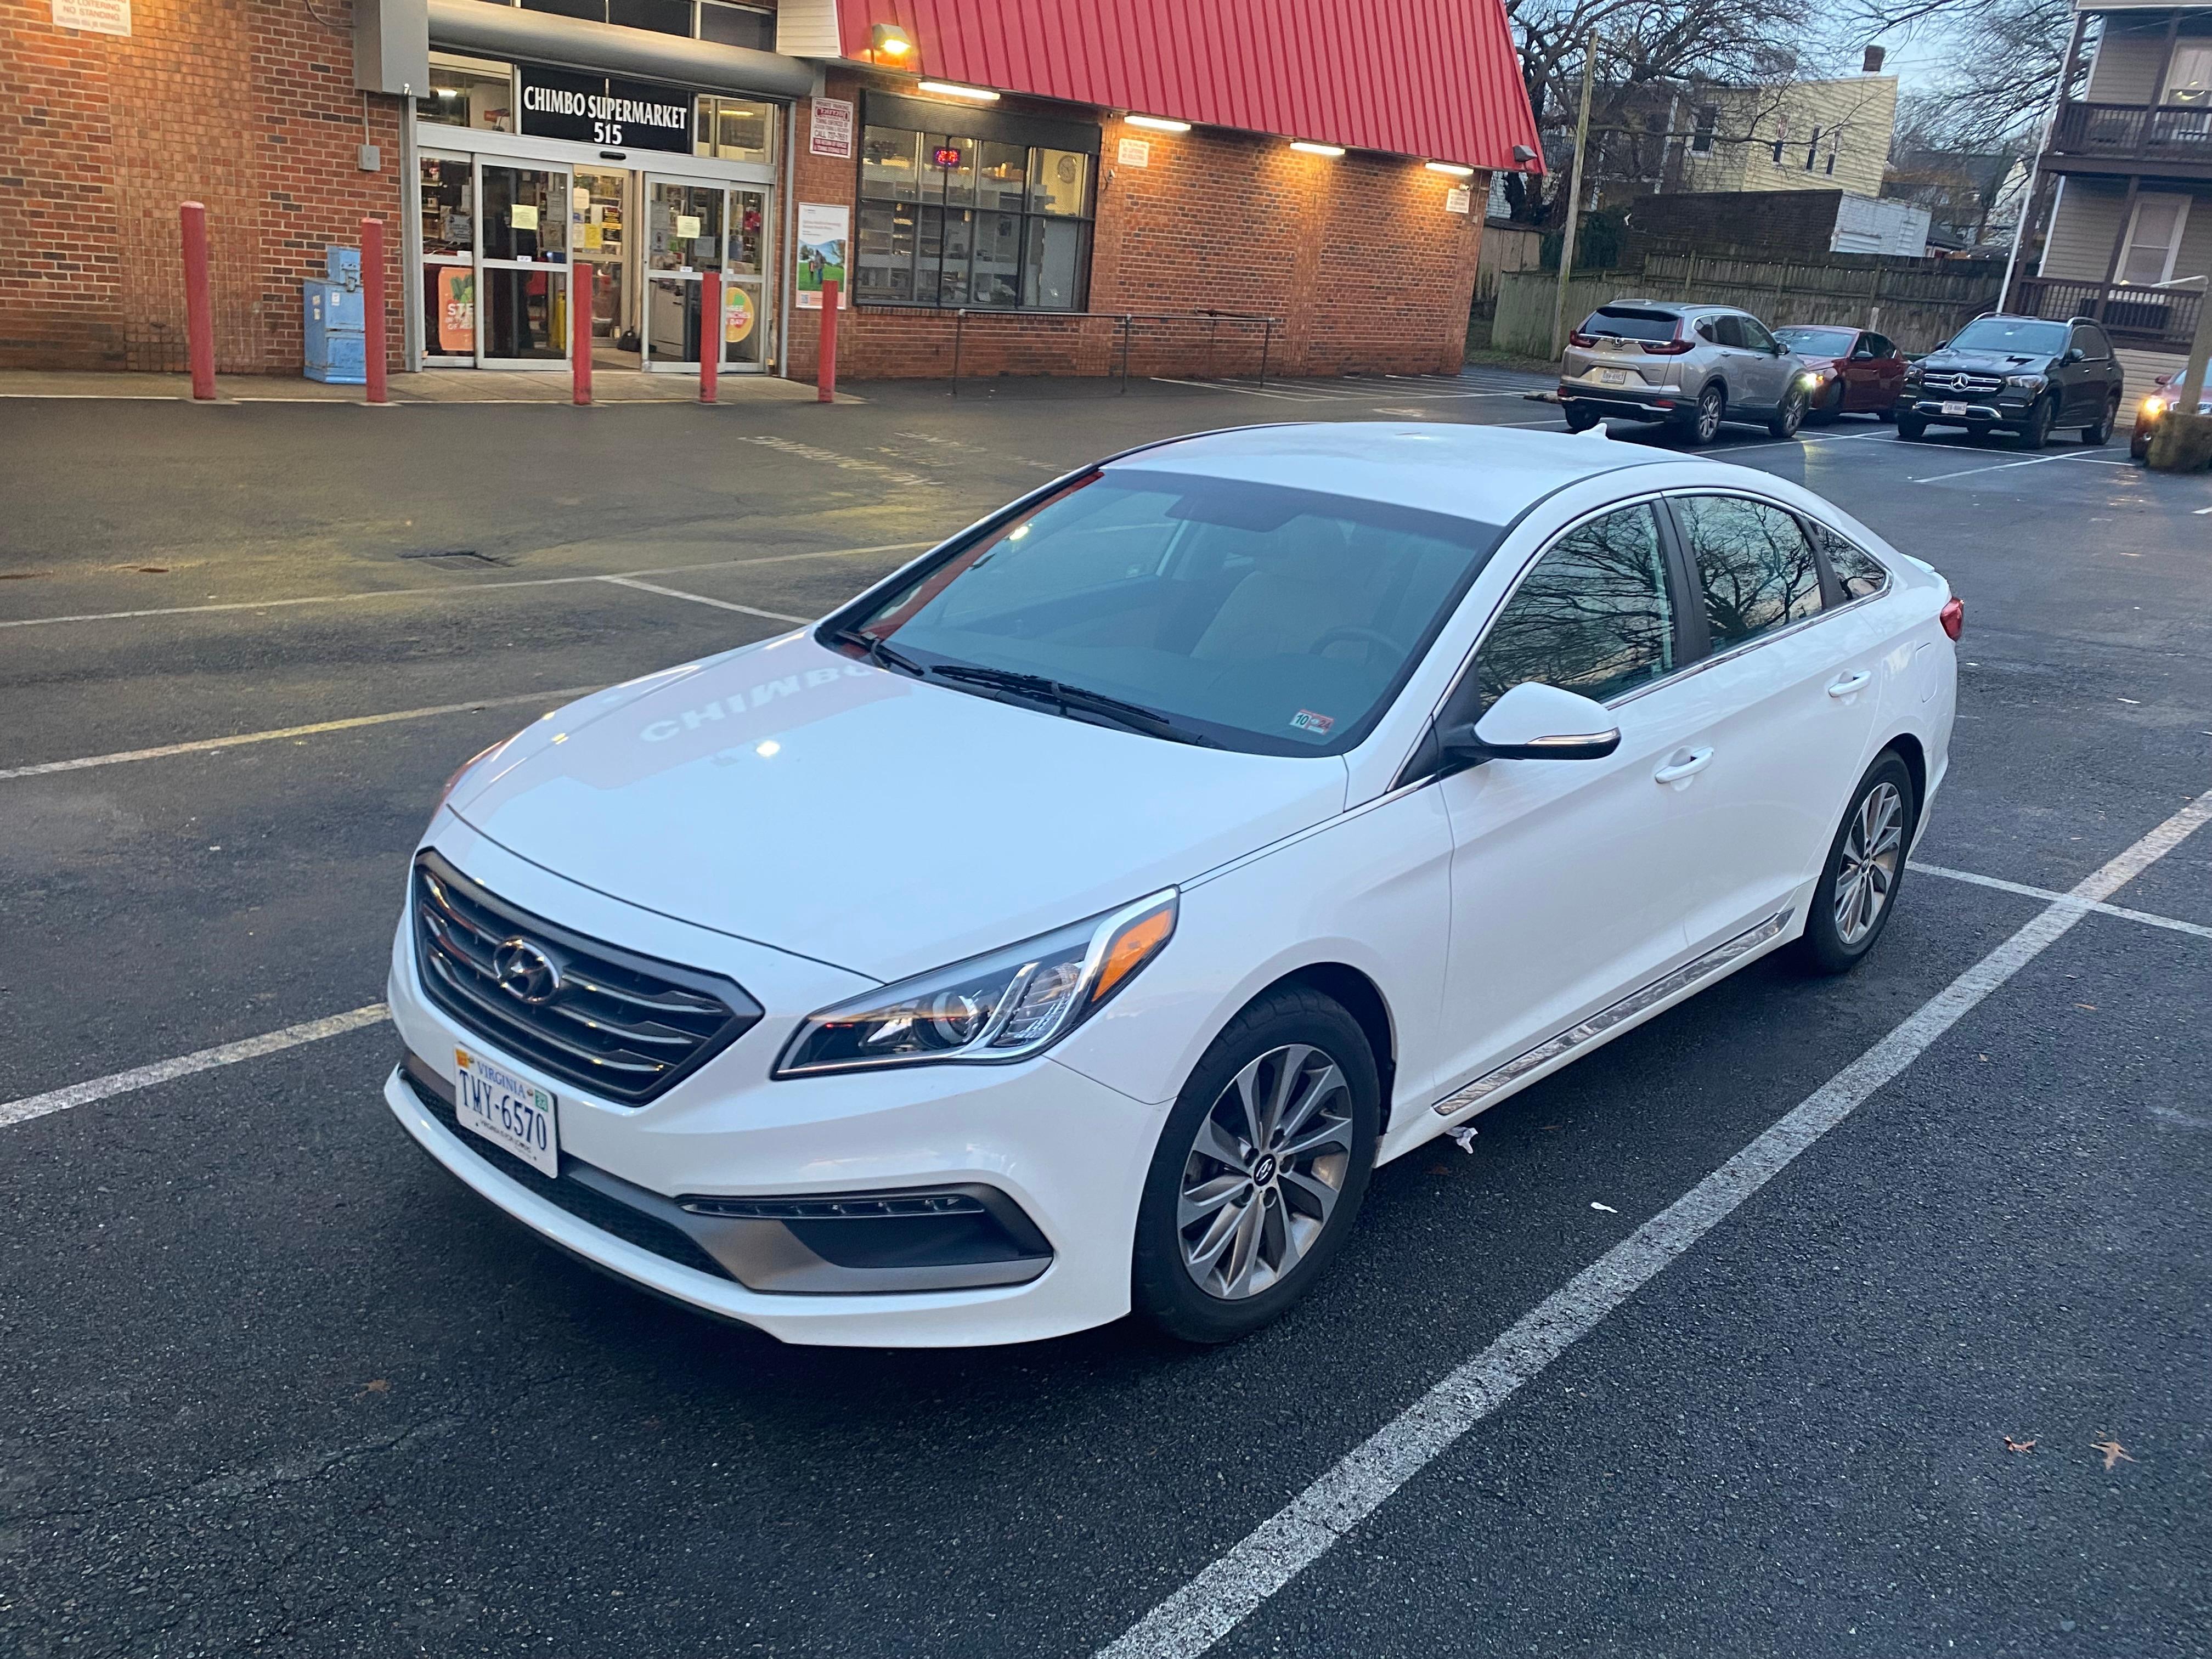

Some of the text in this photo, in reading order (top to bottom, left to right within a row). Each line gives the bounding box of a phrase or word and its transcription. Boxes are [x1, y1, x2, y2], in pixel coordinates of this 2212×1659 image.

[63, 5, 120, 21] NO STANDING
[523, 86, 687, 129] CHIMBO SUPERMARKET
[594, 122, 622, 145] 515
[814, 129, 826, 138] CALL
[1295, 714, 1309, 725] 10
[477, 1061, 526, 1099] VIRGINIA
